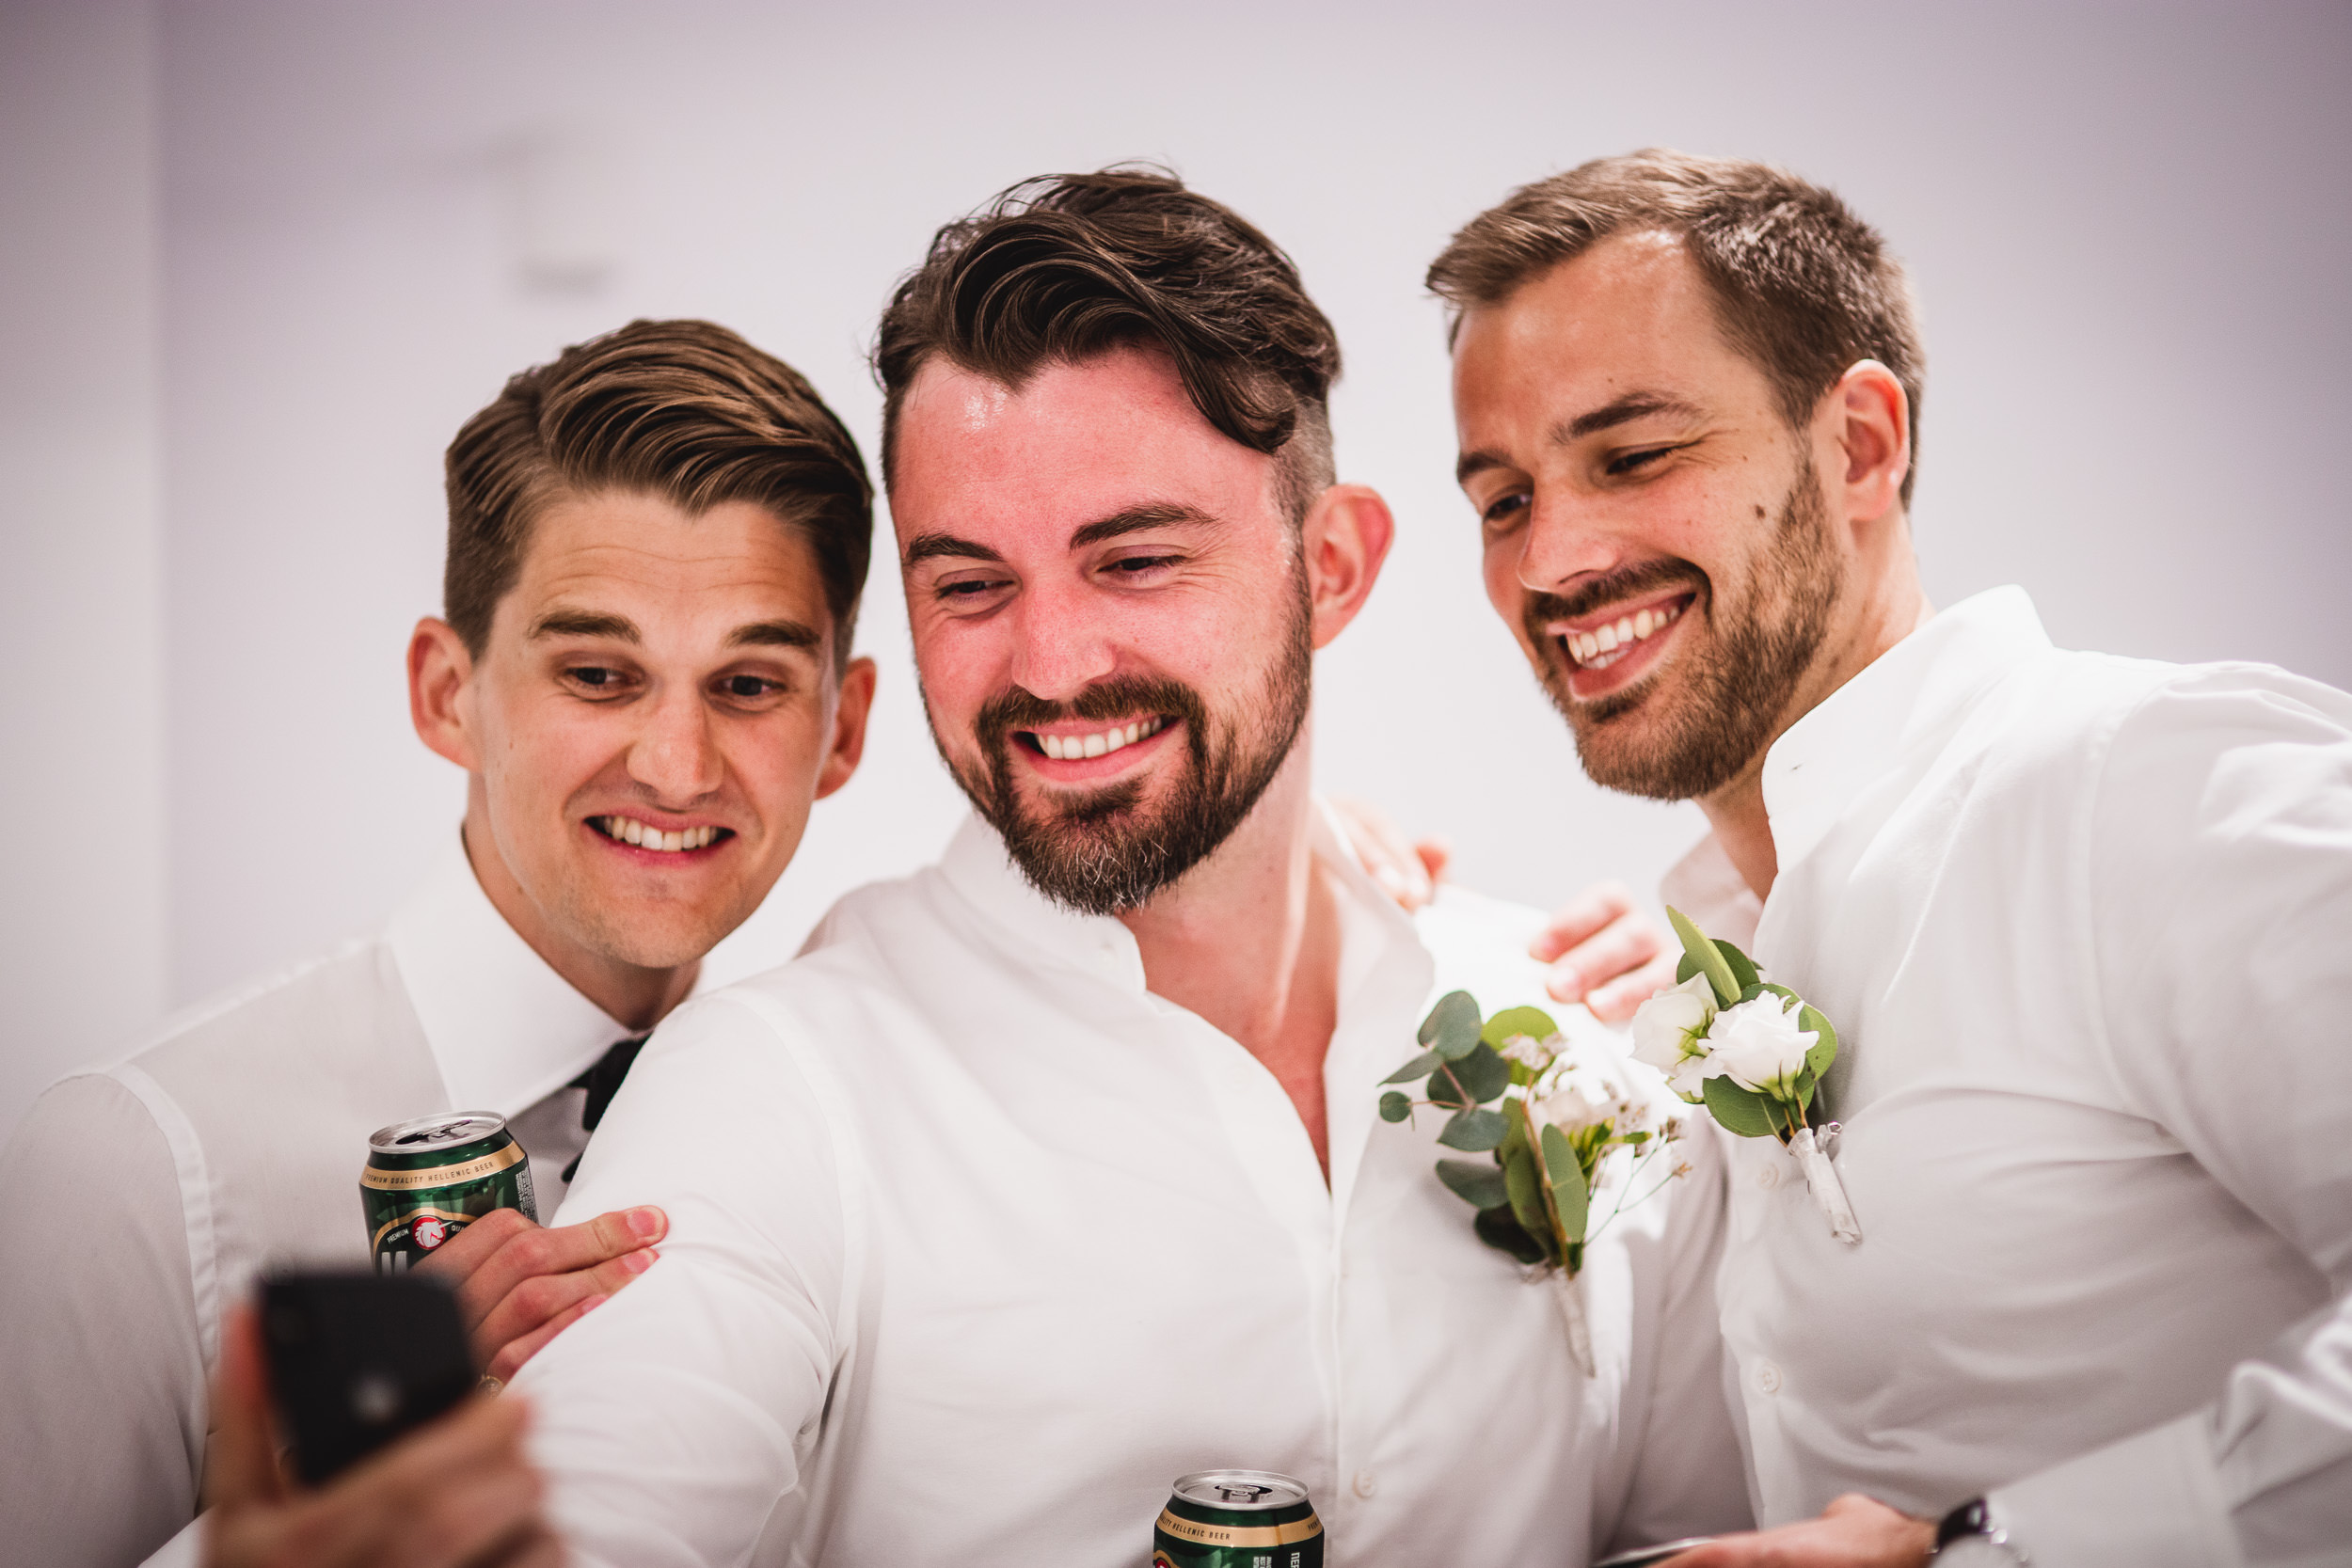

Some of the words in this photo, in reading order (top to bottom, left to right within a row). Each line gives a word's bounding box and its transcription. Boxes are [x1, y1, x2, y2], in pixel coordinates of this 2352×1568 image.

[366, 1173, 388, 1183] PREMIUM
[390, 1176, 423, 1184] QUALITY
[427, 1168, 470, 1182] HELLENIC
[474, 1162, 494, 1173] BEER
[387, 1228, 409, 1244] PREMIUM
[1172, 1523, 1205, 1537] HELLENIC
[1209, 1532, 1231, 1541] BEER
